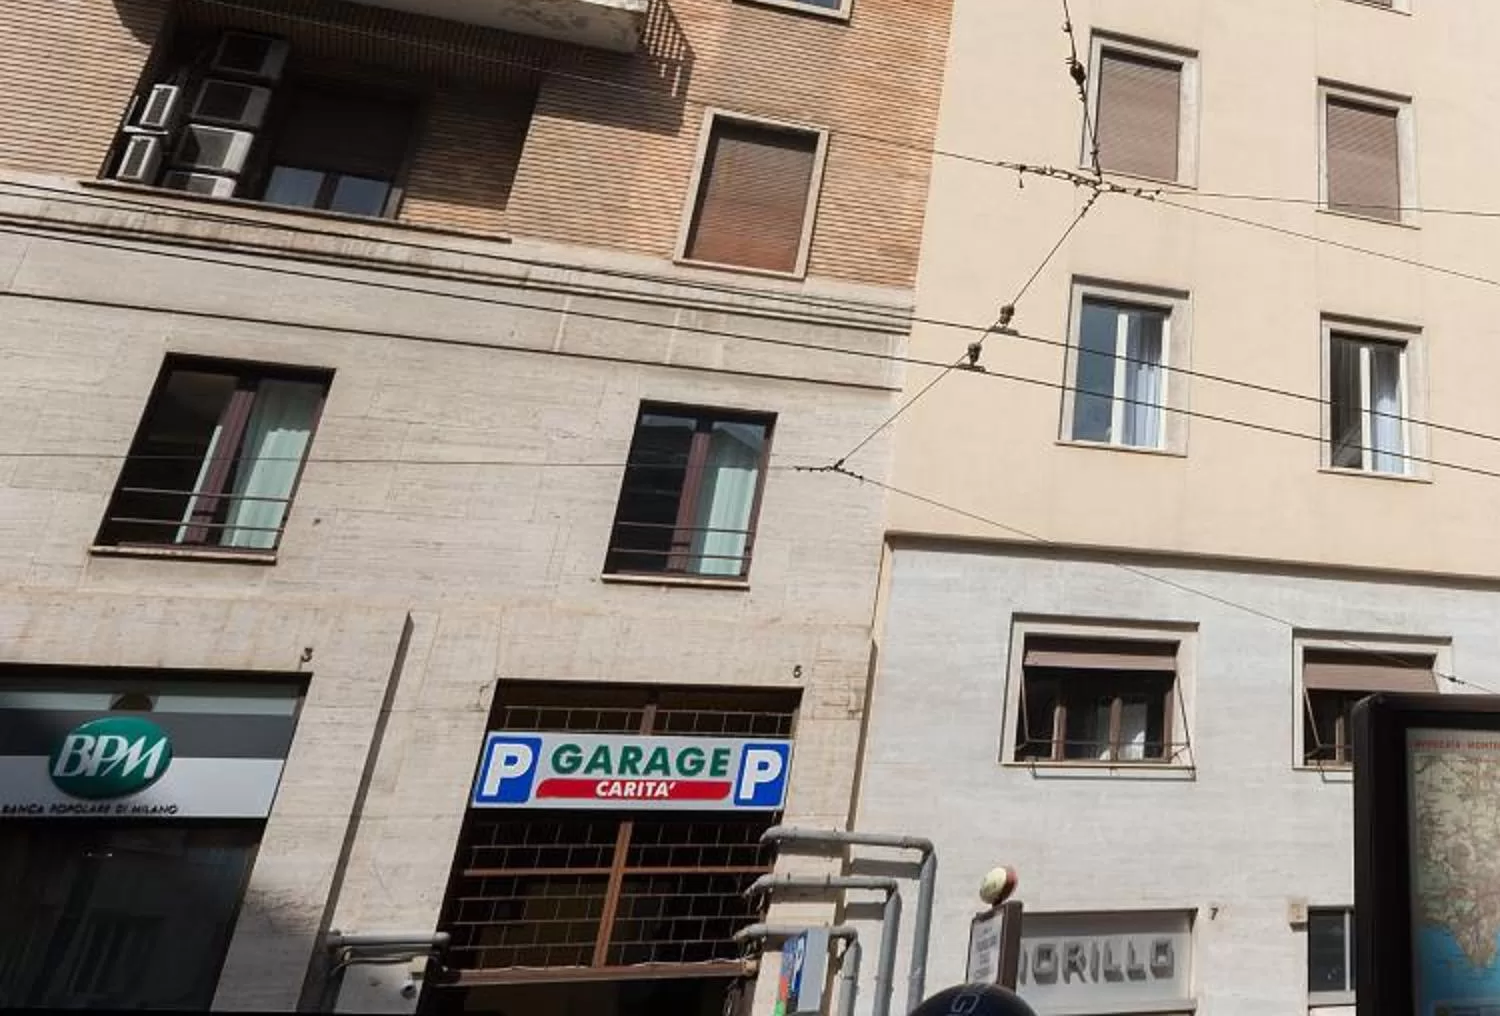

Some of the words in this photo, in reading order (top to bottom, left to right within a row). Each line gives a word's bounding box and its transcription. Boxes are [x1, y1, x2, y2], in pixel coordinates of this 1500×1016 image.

[300, 646, 313, 663] 3
[53, 734, 168, 779] BPM
[482, 743, 534, 797] P
[551, 743, 732, 777] GARAGE
[595, 781, 676, 798] CARITA'
[739, 749, 782, 800] P
[131, 804, 178, 816] MILANO
[1208, 906, 1219, 921] 7
[1020, 937, 1175, 986] IORILLO
